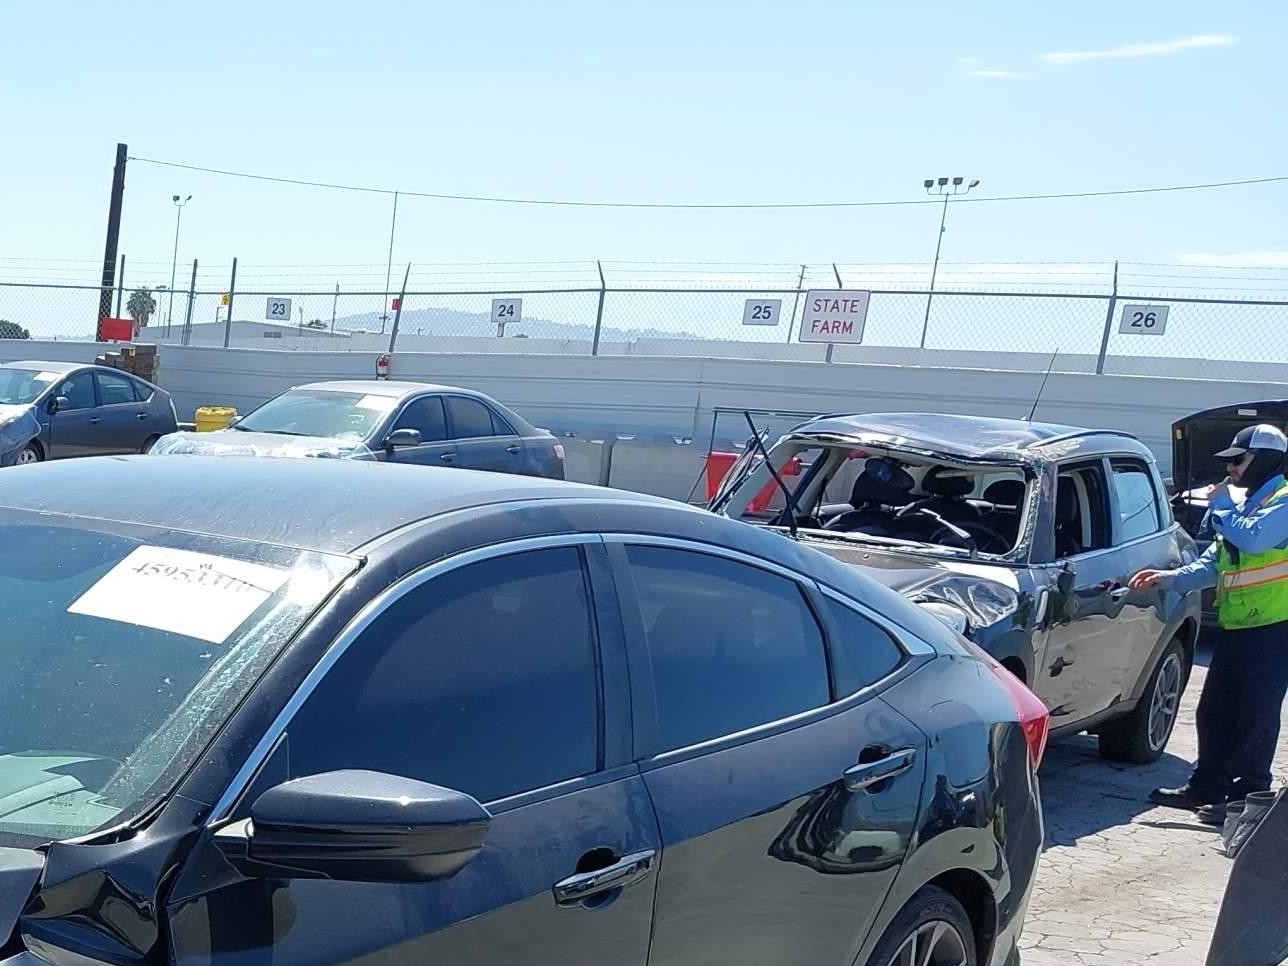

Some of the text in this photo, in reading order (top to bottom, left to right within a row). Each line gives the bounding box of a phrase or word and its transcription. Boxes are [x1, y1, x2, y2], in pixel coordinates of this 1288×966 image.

[272, 302, 286, 315] 23
[498, 304, 514, 317] 24
[751, 305, 772, 320] 25
[813, 298, 860, 313] STATE
[811, 319, 854, 335] FARM
[1131, 311, 1156, 328] 26
